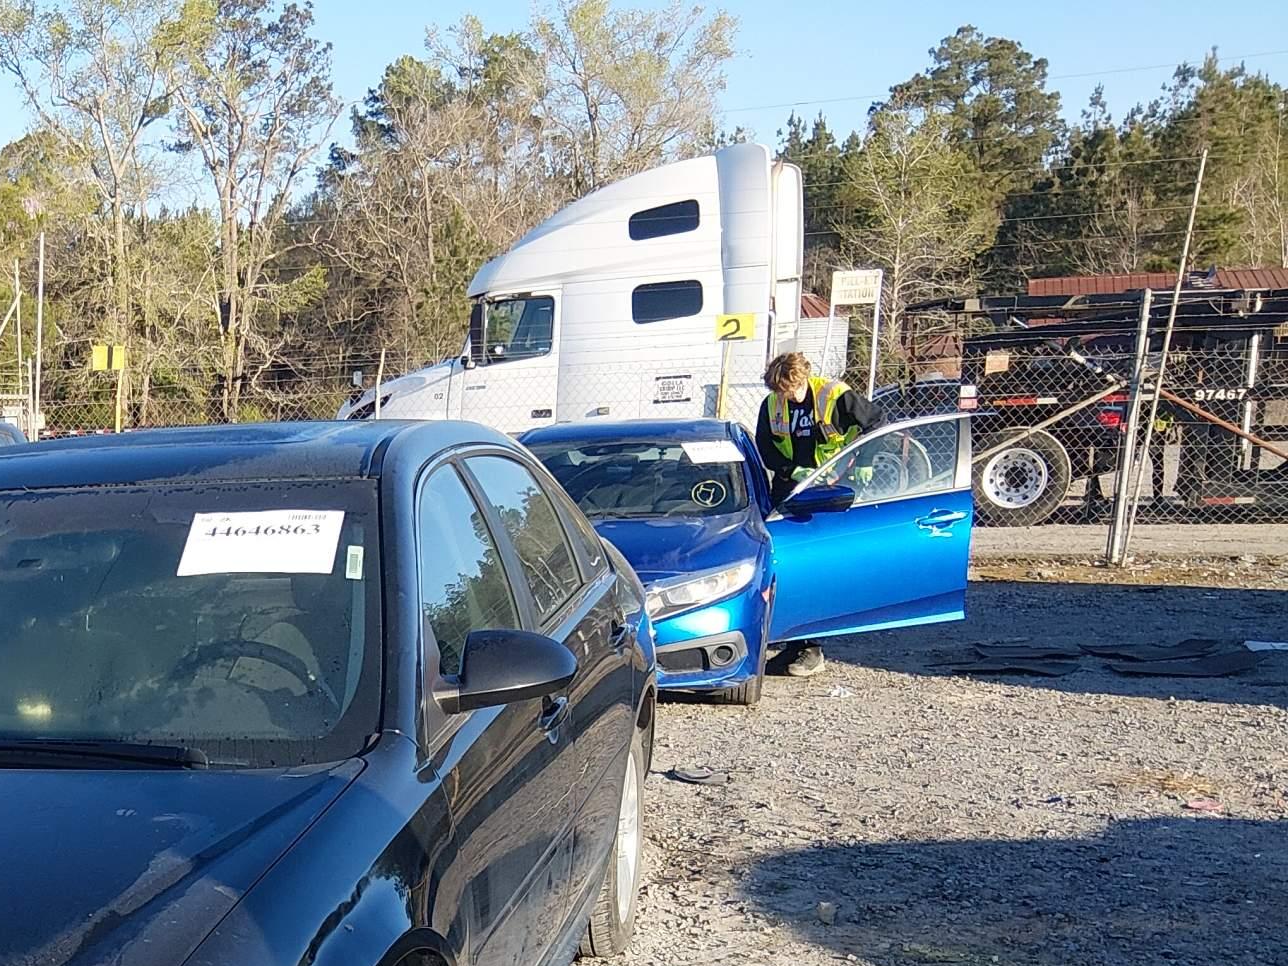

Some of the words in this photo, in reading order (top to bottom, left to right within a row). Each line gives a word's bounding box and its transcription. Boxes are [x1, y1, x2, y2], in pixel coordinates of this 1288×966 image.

[718, 318, 747, 341] 2
[434, 392, 444, 400] 02
[1195, 388, 1248, 400] 97467
[205, 523, 321, 537] 44646863
